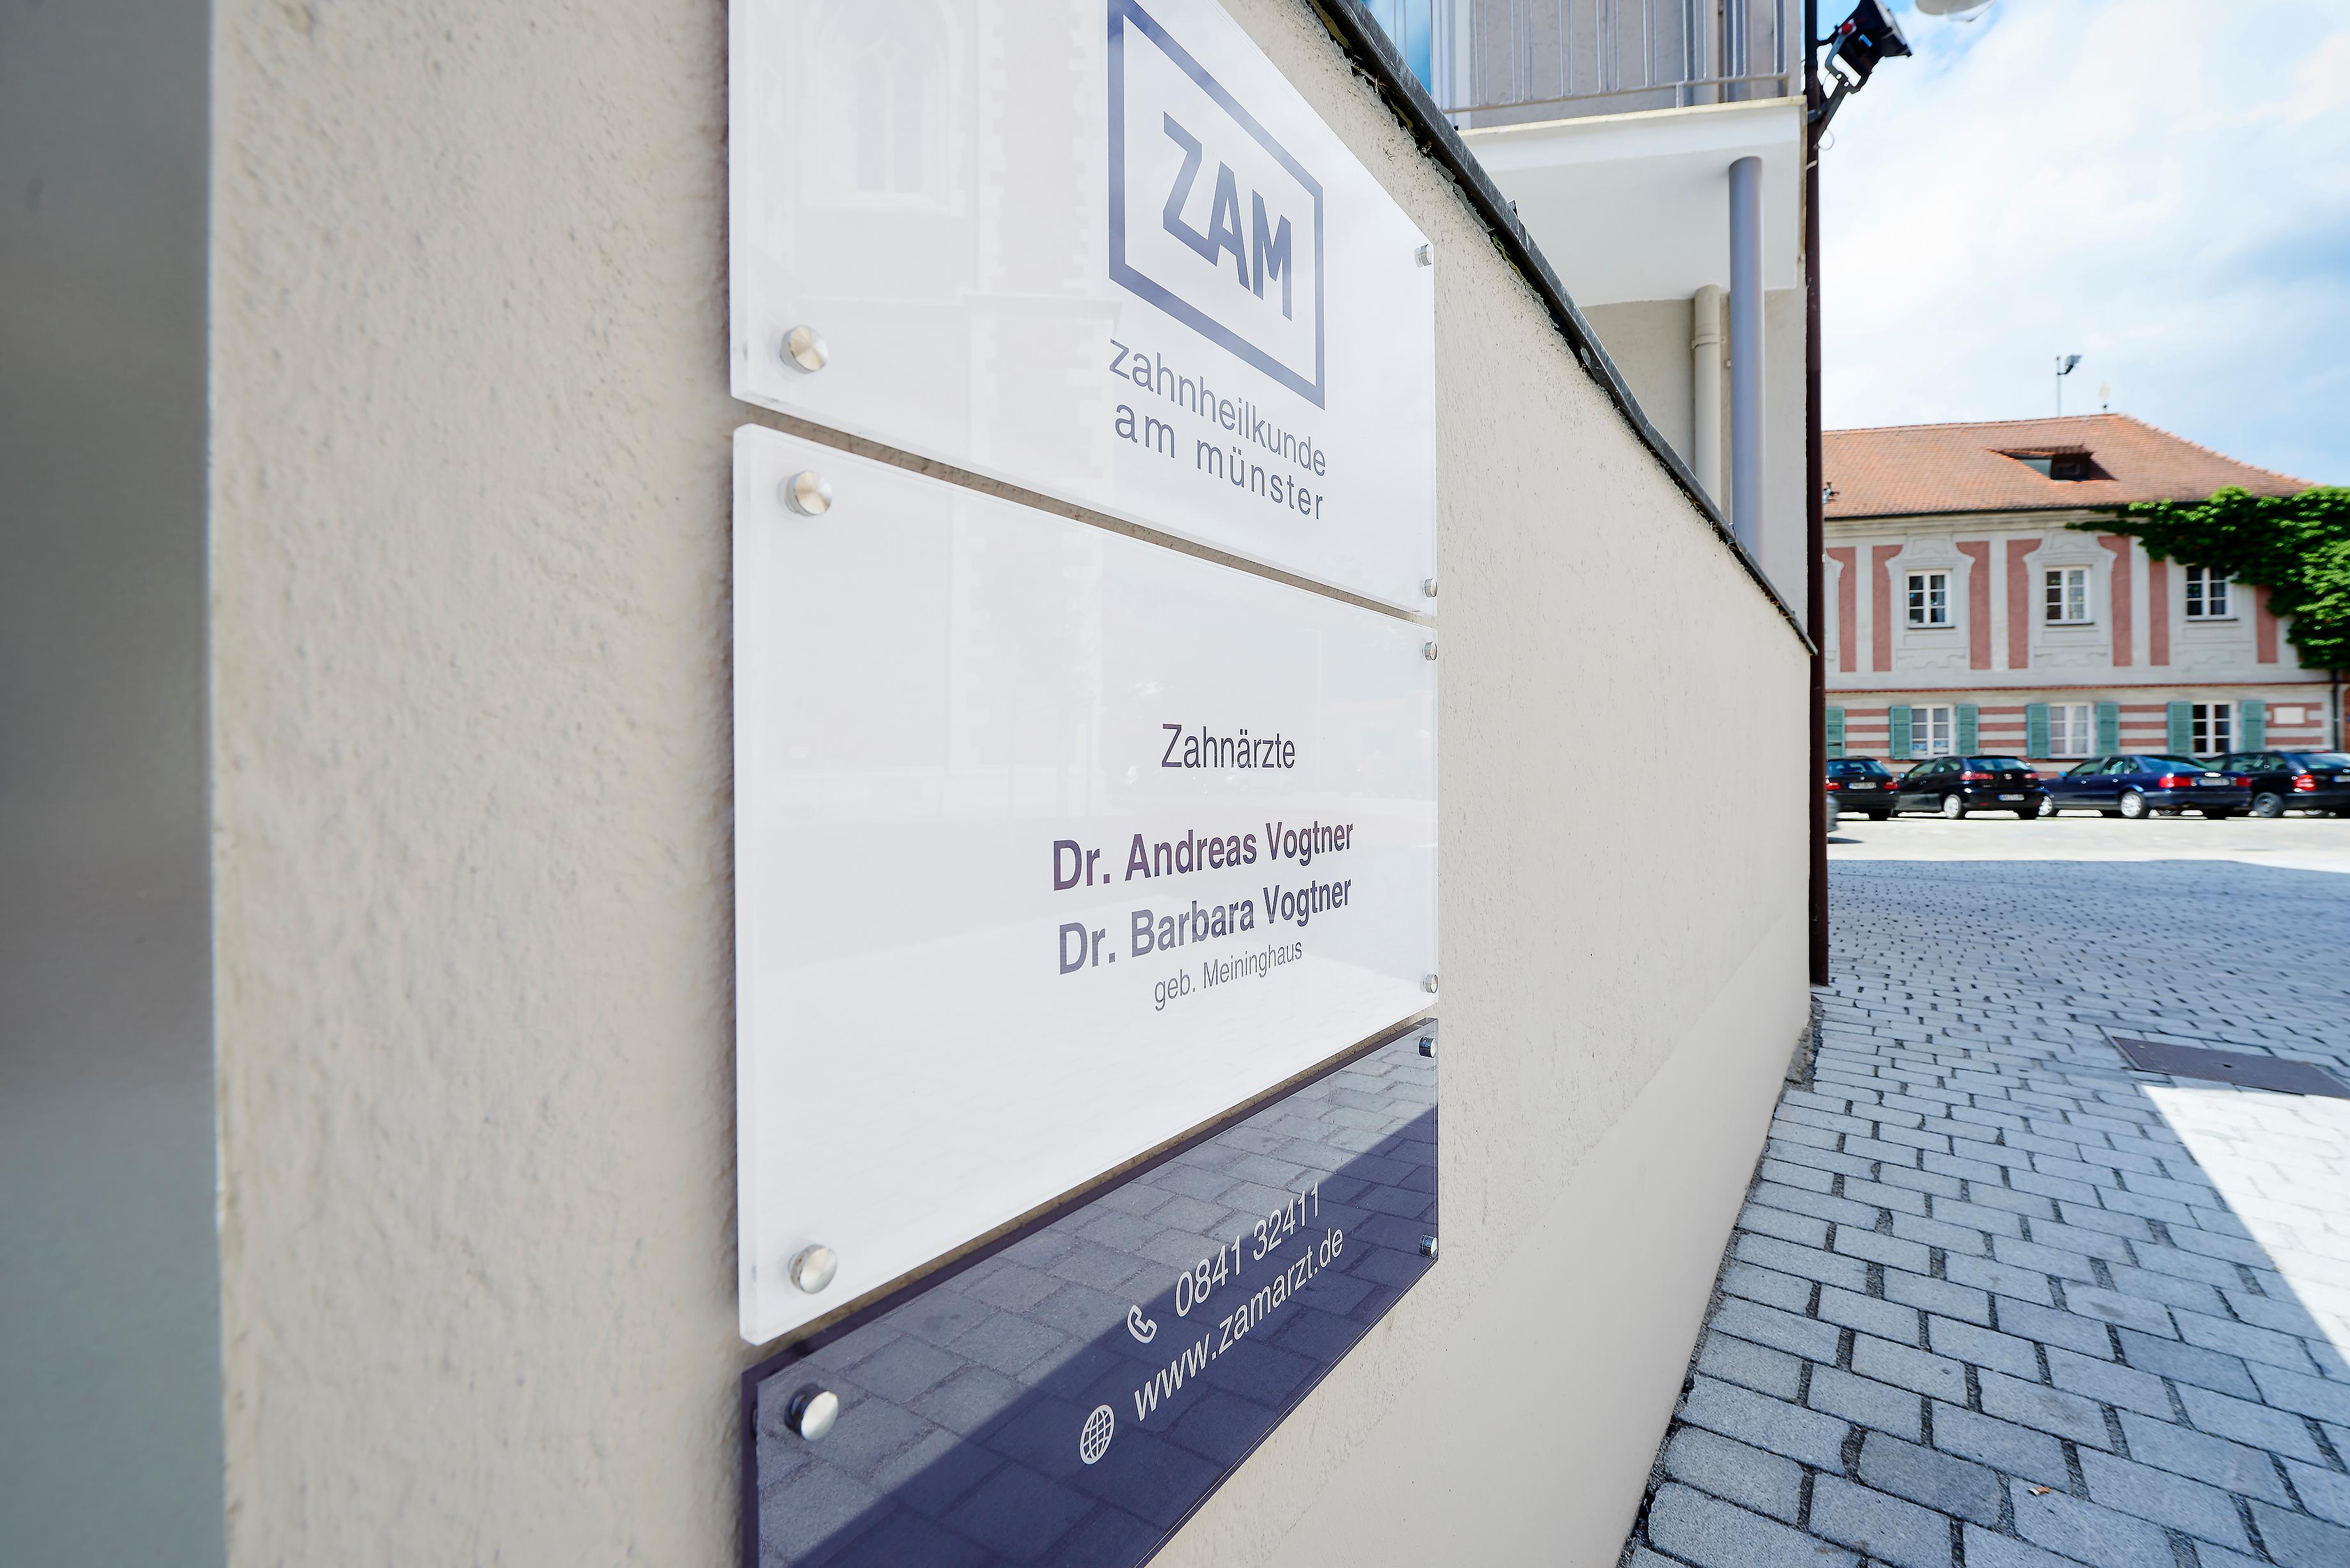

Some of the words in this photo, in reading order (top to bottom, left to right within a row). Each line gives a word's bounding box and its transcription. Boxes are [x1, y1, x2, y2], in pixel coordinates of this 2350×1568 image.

[1163, 110, 1292, 321] ZAM
[1109, 338, 1326, 477] zahnheilkunde
[1115, 403, 1175, 458] am
[1196, 439, 1324, 520] münster
[1162, 723, 1295, 769] Zahnärzte
[1053, 840, 1111, 891] Dr.
[1125, 829, 1257, 881] Andreas
[1265, 820, 1353, 866] Vogtner
[1059, 921, 1116, 975] Dr.
[1131, 900, 1254, 957] Barbara
[1263, 879, 1351, 927] Vogtner
[1154, 969, 1195, 1011] geb.
[1204, 942, 1303, 988] Meininghaus
[1176, 1235, 1241, 1317] 0841
[1253, 1182, 1320, 1261] 32411
[1134, 1228, 1343, 1421] www.zamarzt.de
